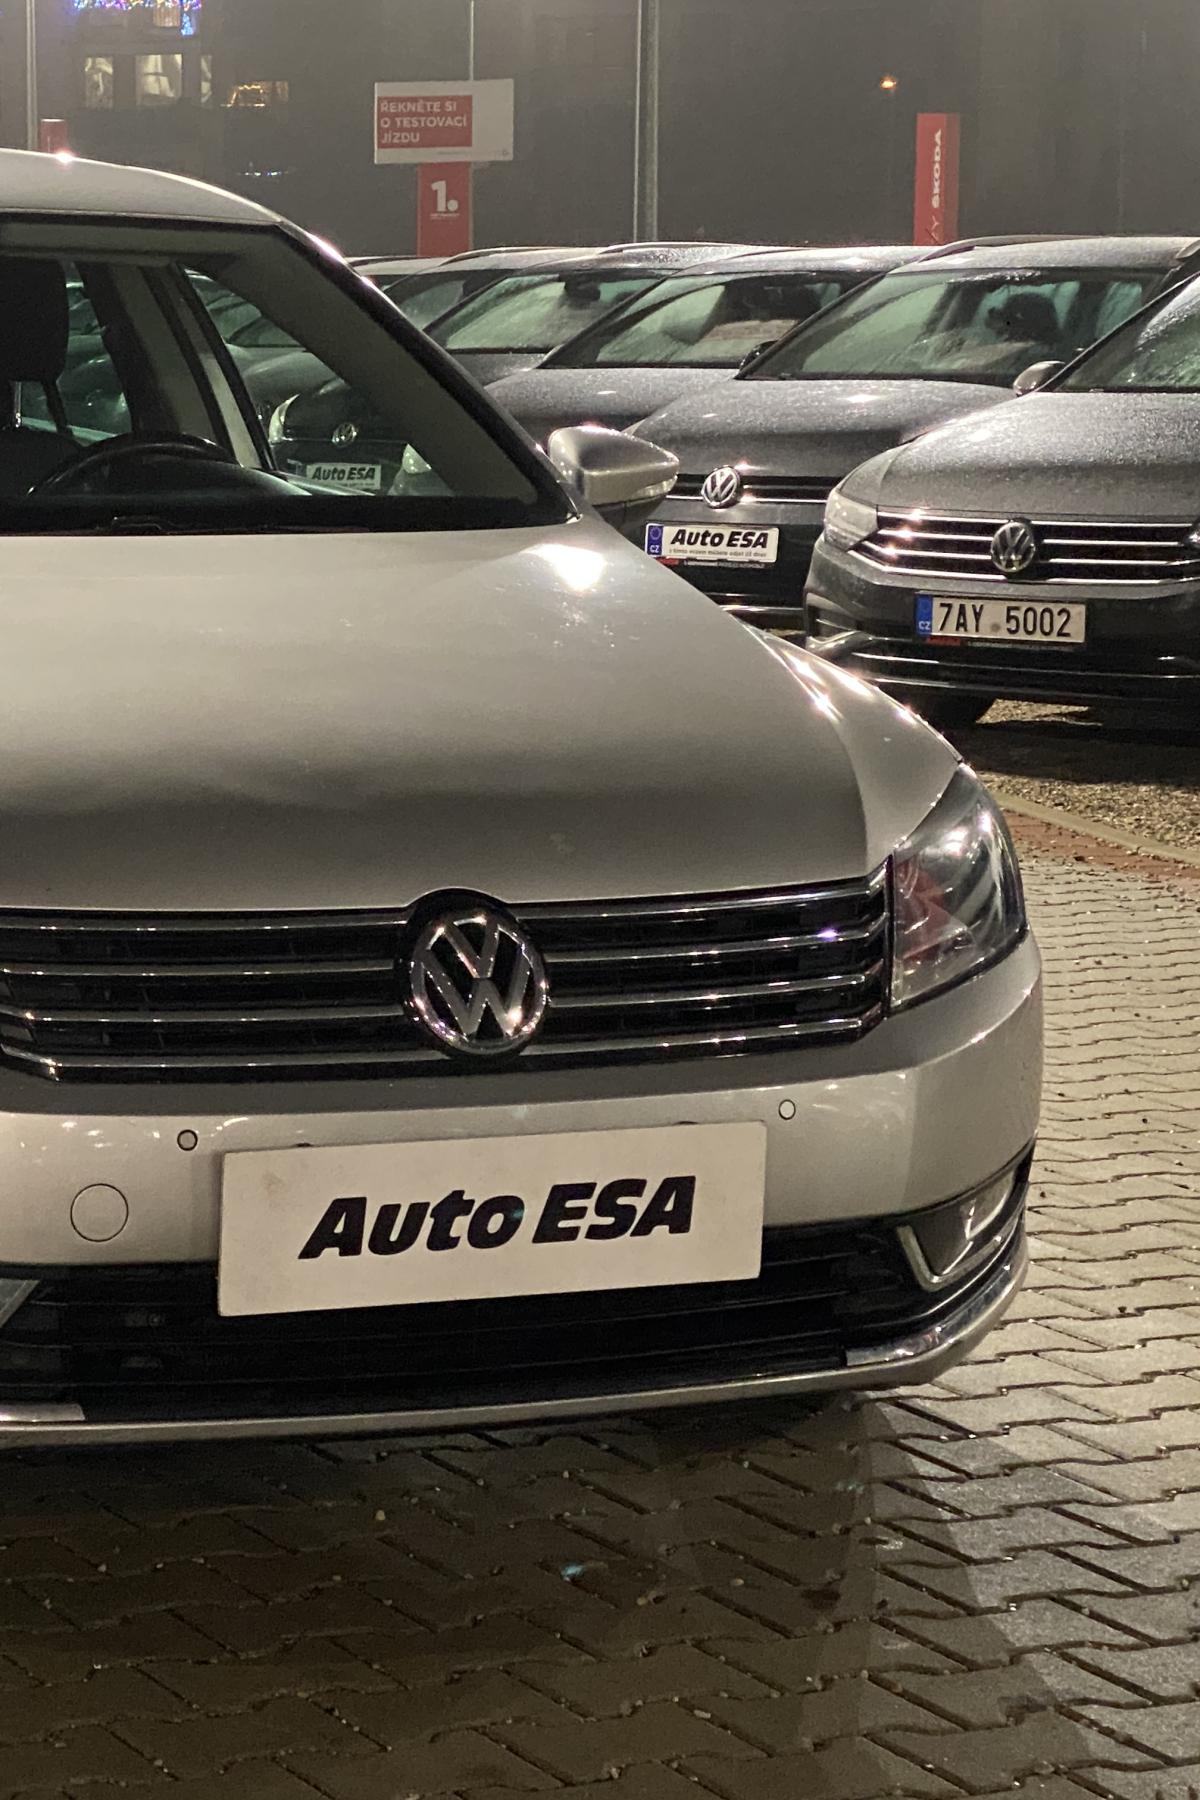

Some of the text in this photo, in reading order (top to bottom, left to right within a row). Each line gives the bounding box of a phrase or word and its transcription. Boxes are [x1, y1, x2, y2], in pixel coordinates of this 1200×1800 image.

[380, 100, 456, 113] ŘEKNĚTE SI
[380, 114, 467, 128] O TESTOVACÍ
[381, 130, 420, 143] JÍZDU
[430, 180, 459, 212] 1.
[312, 466, 376, 481] Auto ESA
[671, 529, 769, 548] Auto ESA
[649, 544, 660, 554] CZ
[918, 620, 931, 631] CZ
[939, 602, 1072, 637] 7AY 5002
[298, 1175, 697, 1260] Auto ESA
